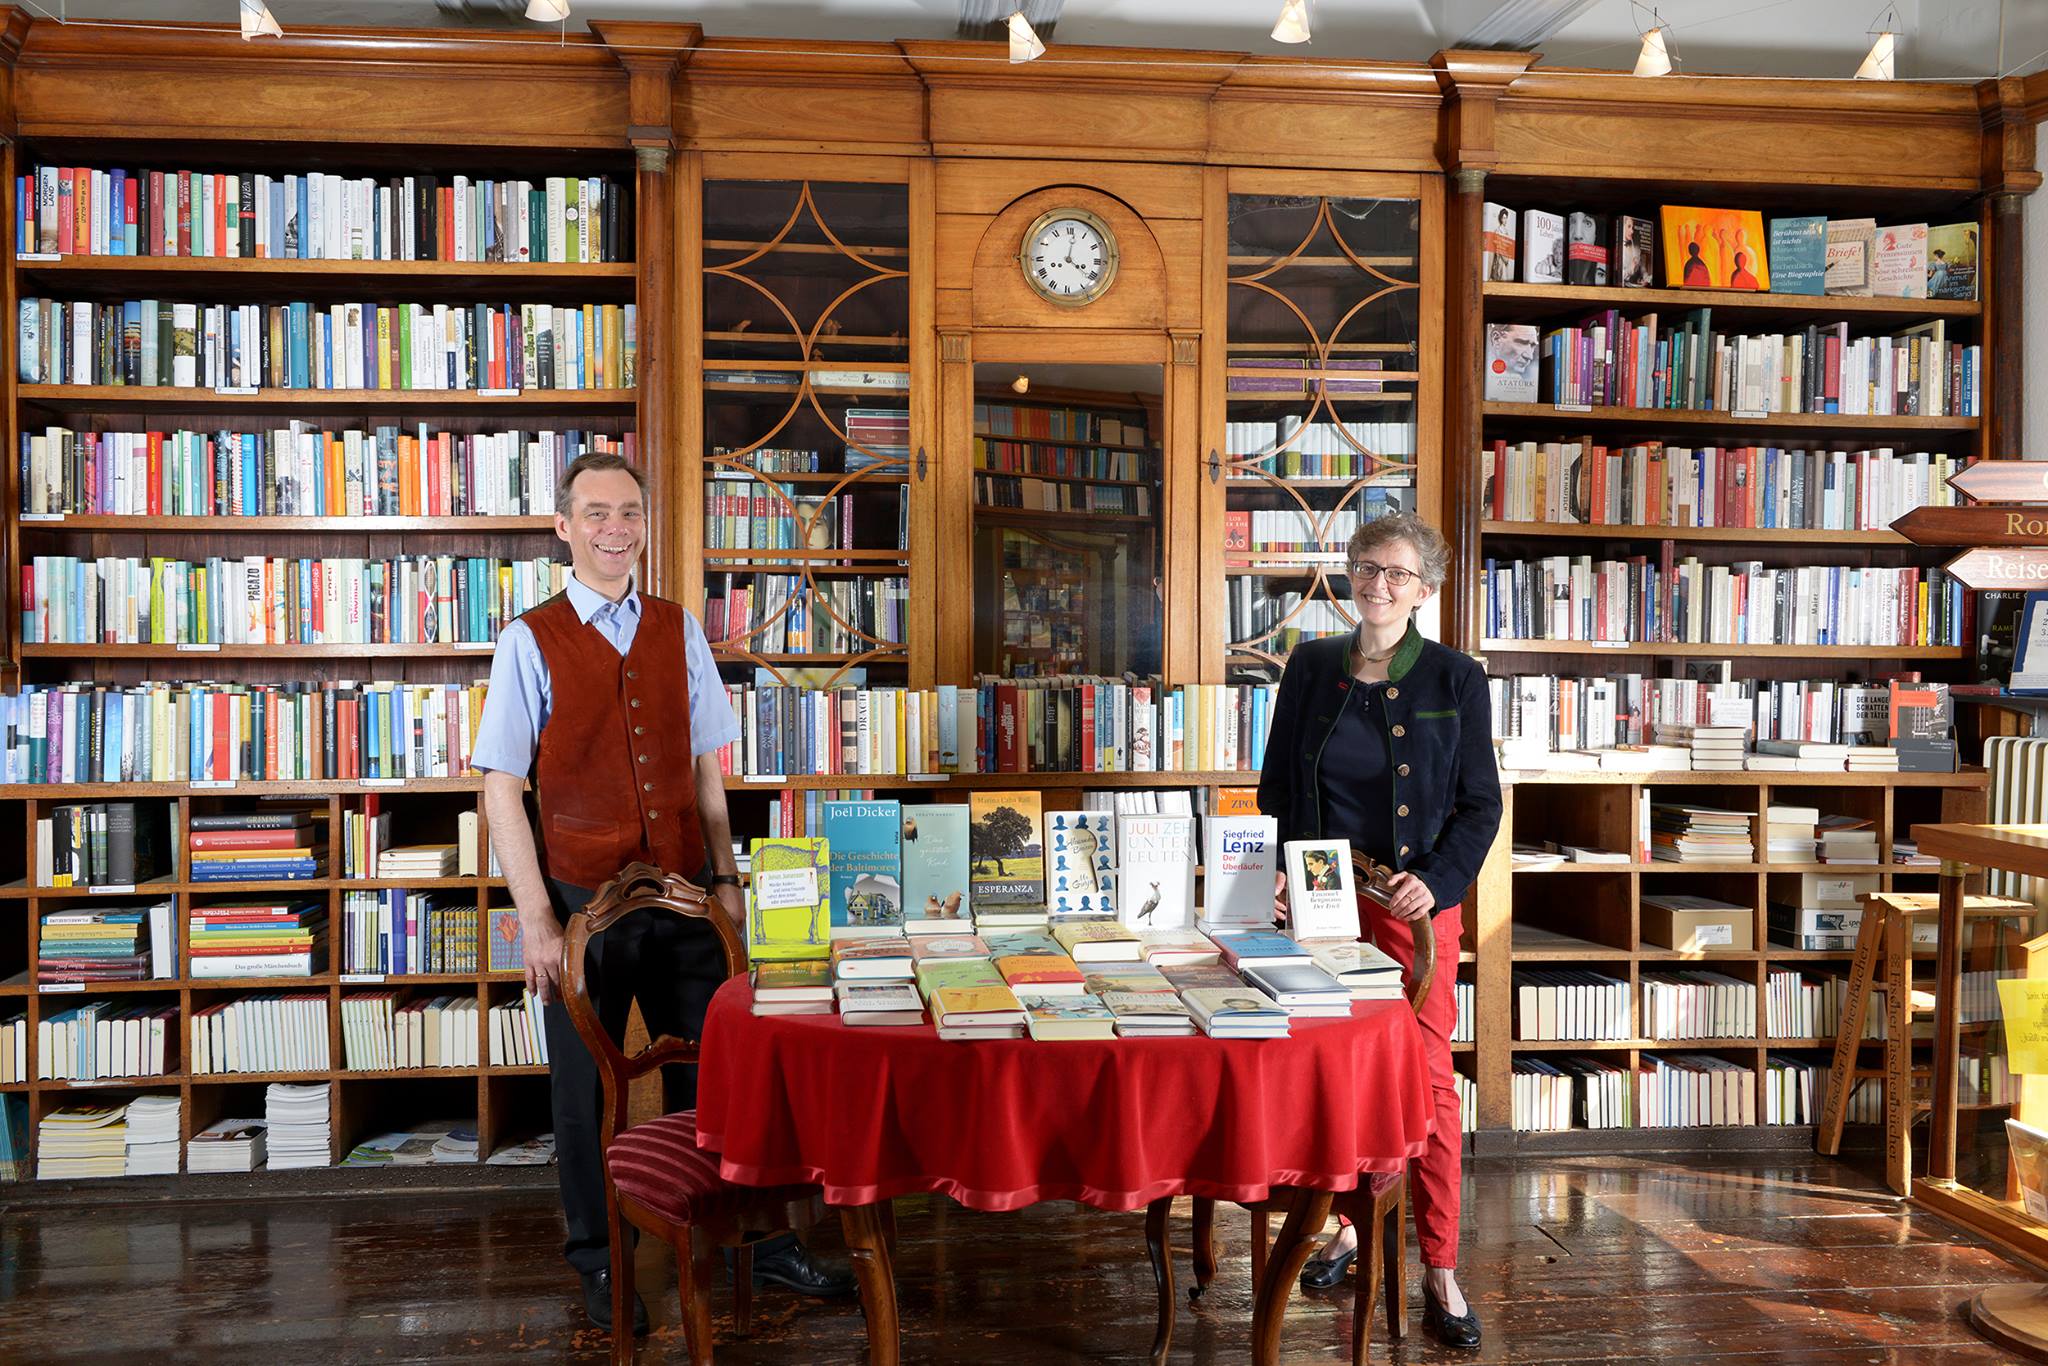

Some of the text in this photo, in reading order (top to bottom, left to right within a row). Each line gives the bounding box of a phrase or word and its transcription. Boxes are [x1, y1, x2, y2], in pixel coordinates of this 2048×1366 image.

[1536, 216, 1552, 230] 100
[1781, 237, 1802, 245] nichts
[1827, 245, 1862, 259] Briefe!
[1772, 270, 1824, 279] Eine Biographie
[1877, 273, 1914, 282] Geschichte
[1944, 273, 1968, 282] Anmut
[1953, 290, 1972, 298] Sand
[24, 306, 32, 334] RUNA
[584, 314, 593, 357] Charlotte
[1497, 378, 1534, 388] ATATÜRK
[2004, 513, 2048, 535] Ro
[458, 568, 466, 590] WENDE
[248, 568, 260, 601] PACAZO
[1984, 592, 2021, 600] CHARLIE
[858, 694, 867, 731] DRACH
[1856, 711, 1889, 719] DER TÄTER
[1231, 800, 1253, 808] ZPO
[831, 805, 897, 820] Joël Dicker
[246, 815, 281, 824] GRIMMS
[1128, 822, 1191, 836] JULI ZEH
[1223, 829, 1264, 840] Siegfried
[1128, 836, 1192, 849] UNTER
[1222, 838, 1264, 853] Lenz
[829, 851, 898, 861] Die Geschichte
[1128, 851, 1192, 864] LEUTEN
[1222, 854, 1236, 862] Der
[829, 863, 897, 872] der Baltimores
[1222, 861, 1264, 871] Überläufer
[978, 884, 1033, 894] ESPERANZA
[247, 963, 263, 971] große
[264, 962, 303, 970] Märchenbuch
[1827, 944, 1870, 1116] Fischer Taschenbücher
[1889, 970, 1902, 1163] Fischer Taschenbücher
